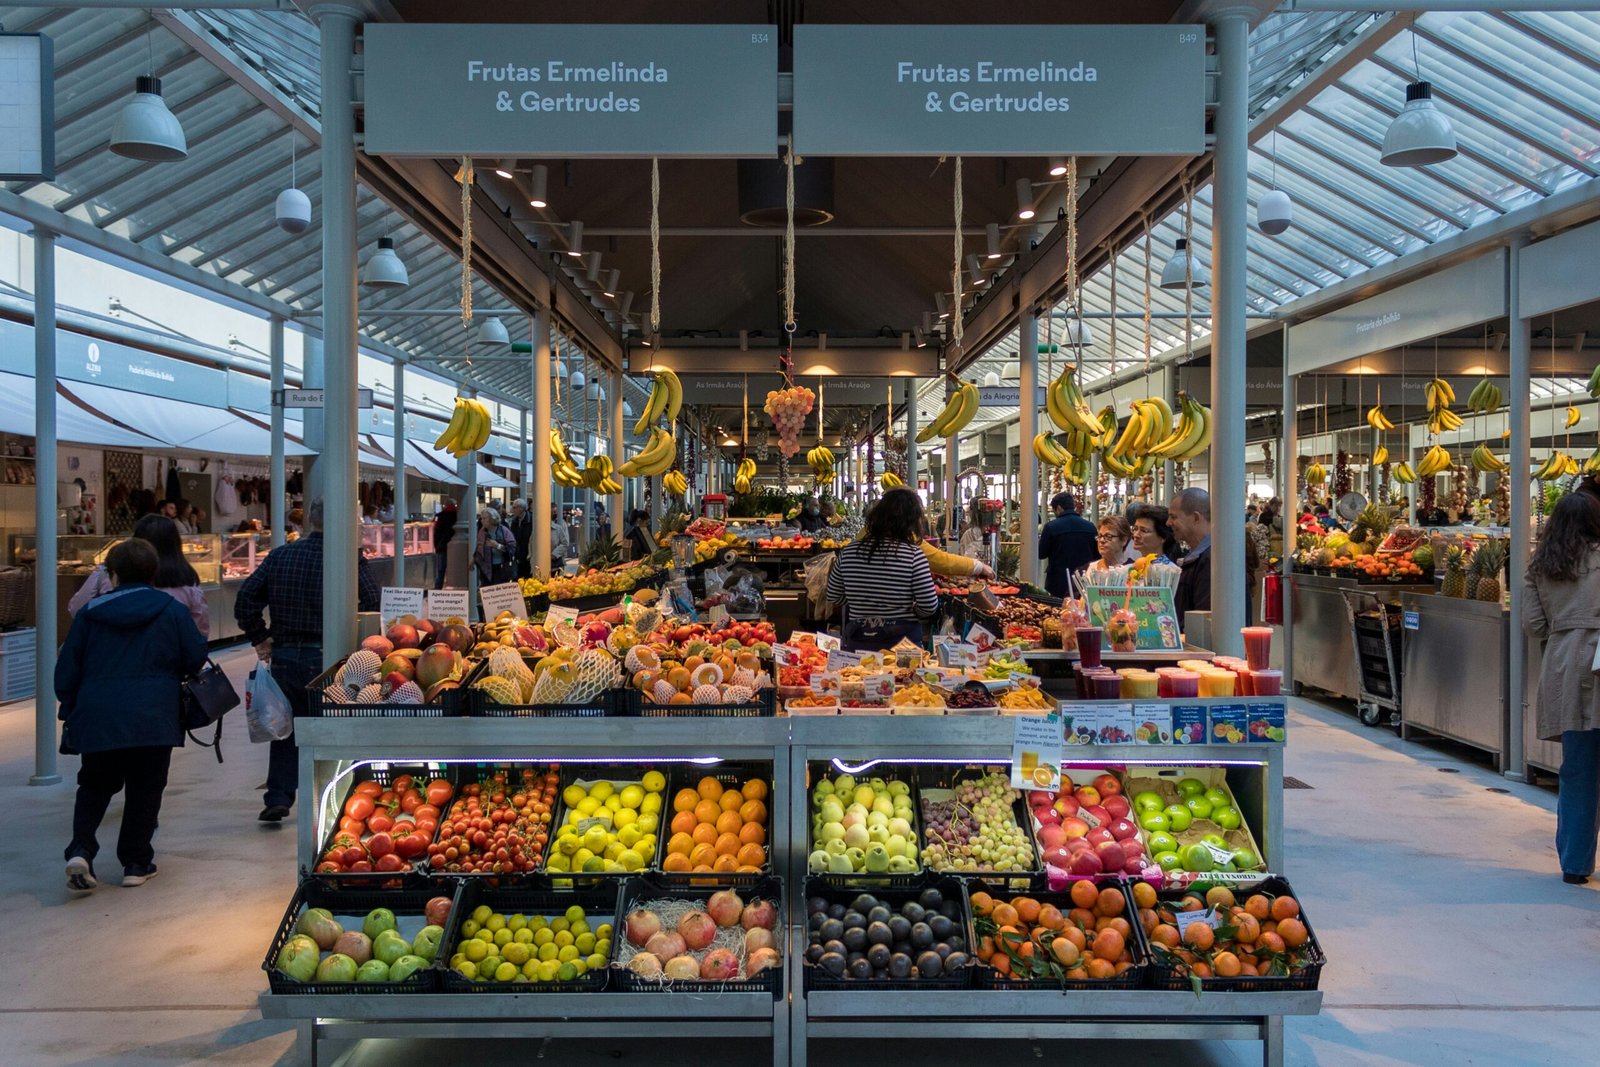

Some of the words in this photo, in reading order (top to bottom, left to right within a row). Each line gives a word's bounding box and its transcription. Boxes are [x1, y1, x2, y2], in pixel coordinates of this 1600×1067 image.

[751, 33, 768, 43] B34
[1179, 33, 1197, 43] B49
[468, 61, 541, 83] Frutas
[548, 61, 668, 83] Ermelinda
[898, 61, 971, 83] Frutas
[977, 61, 1097, 83] Ermelinda
[495, 91, 514, 113] &
[519, 91, 641, 113] Gertrudes
[925, 91, 944, 113] &
[949, 91, 1070, 113] Gertrudes
[706, 381, 725, 389] Irmãs
[828, 381, 847, 389] Irmãs
[848, 381, 871, 390] Araújo
[293, 394, 306, 402] Rua
[308, 394, 318, 402] do
[994, 392, 1020, 402] Alegria
[1136, 588, 1160, 598] Juices
